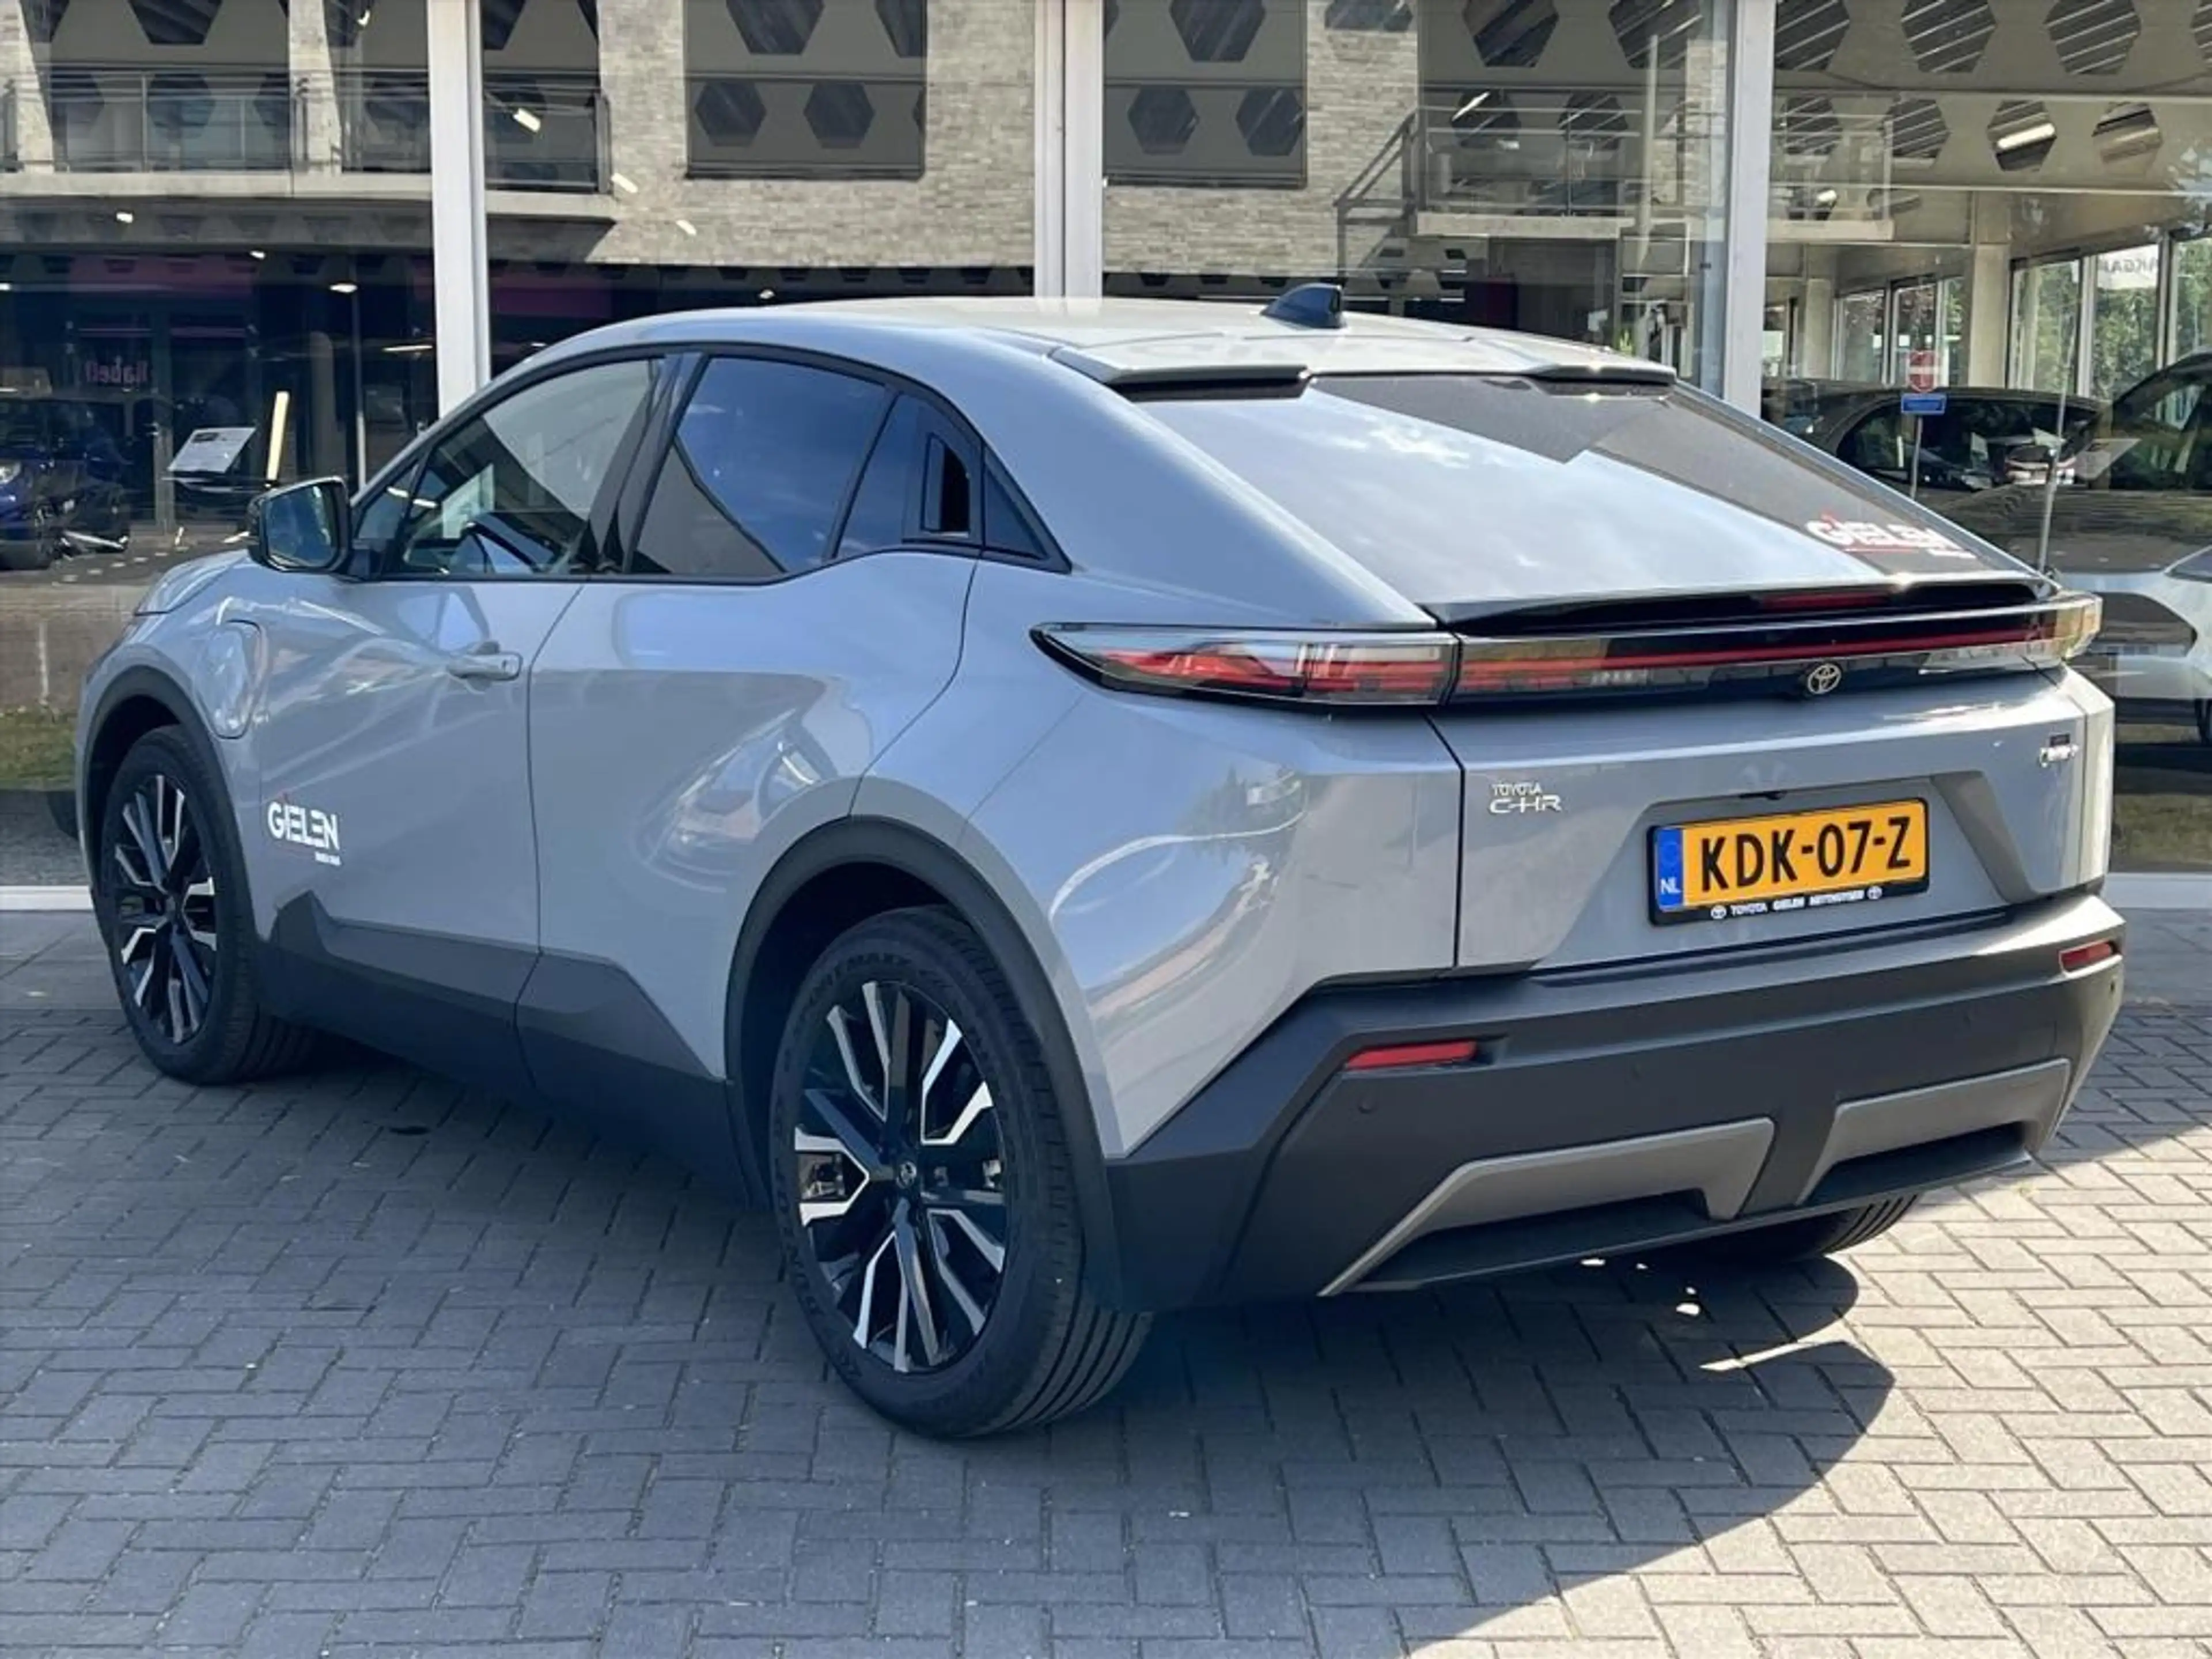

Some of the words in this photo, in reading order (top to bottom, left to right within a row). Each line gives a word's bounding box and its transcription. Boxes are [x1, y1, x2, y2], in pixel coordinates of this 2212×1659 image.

[1492, 781, 1542, 796] TOYOTA
[1701, 816, 1911, 892] KDK-07-Z
[1661, 877, 1681, 894] NL
